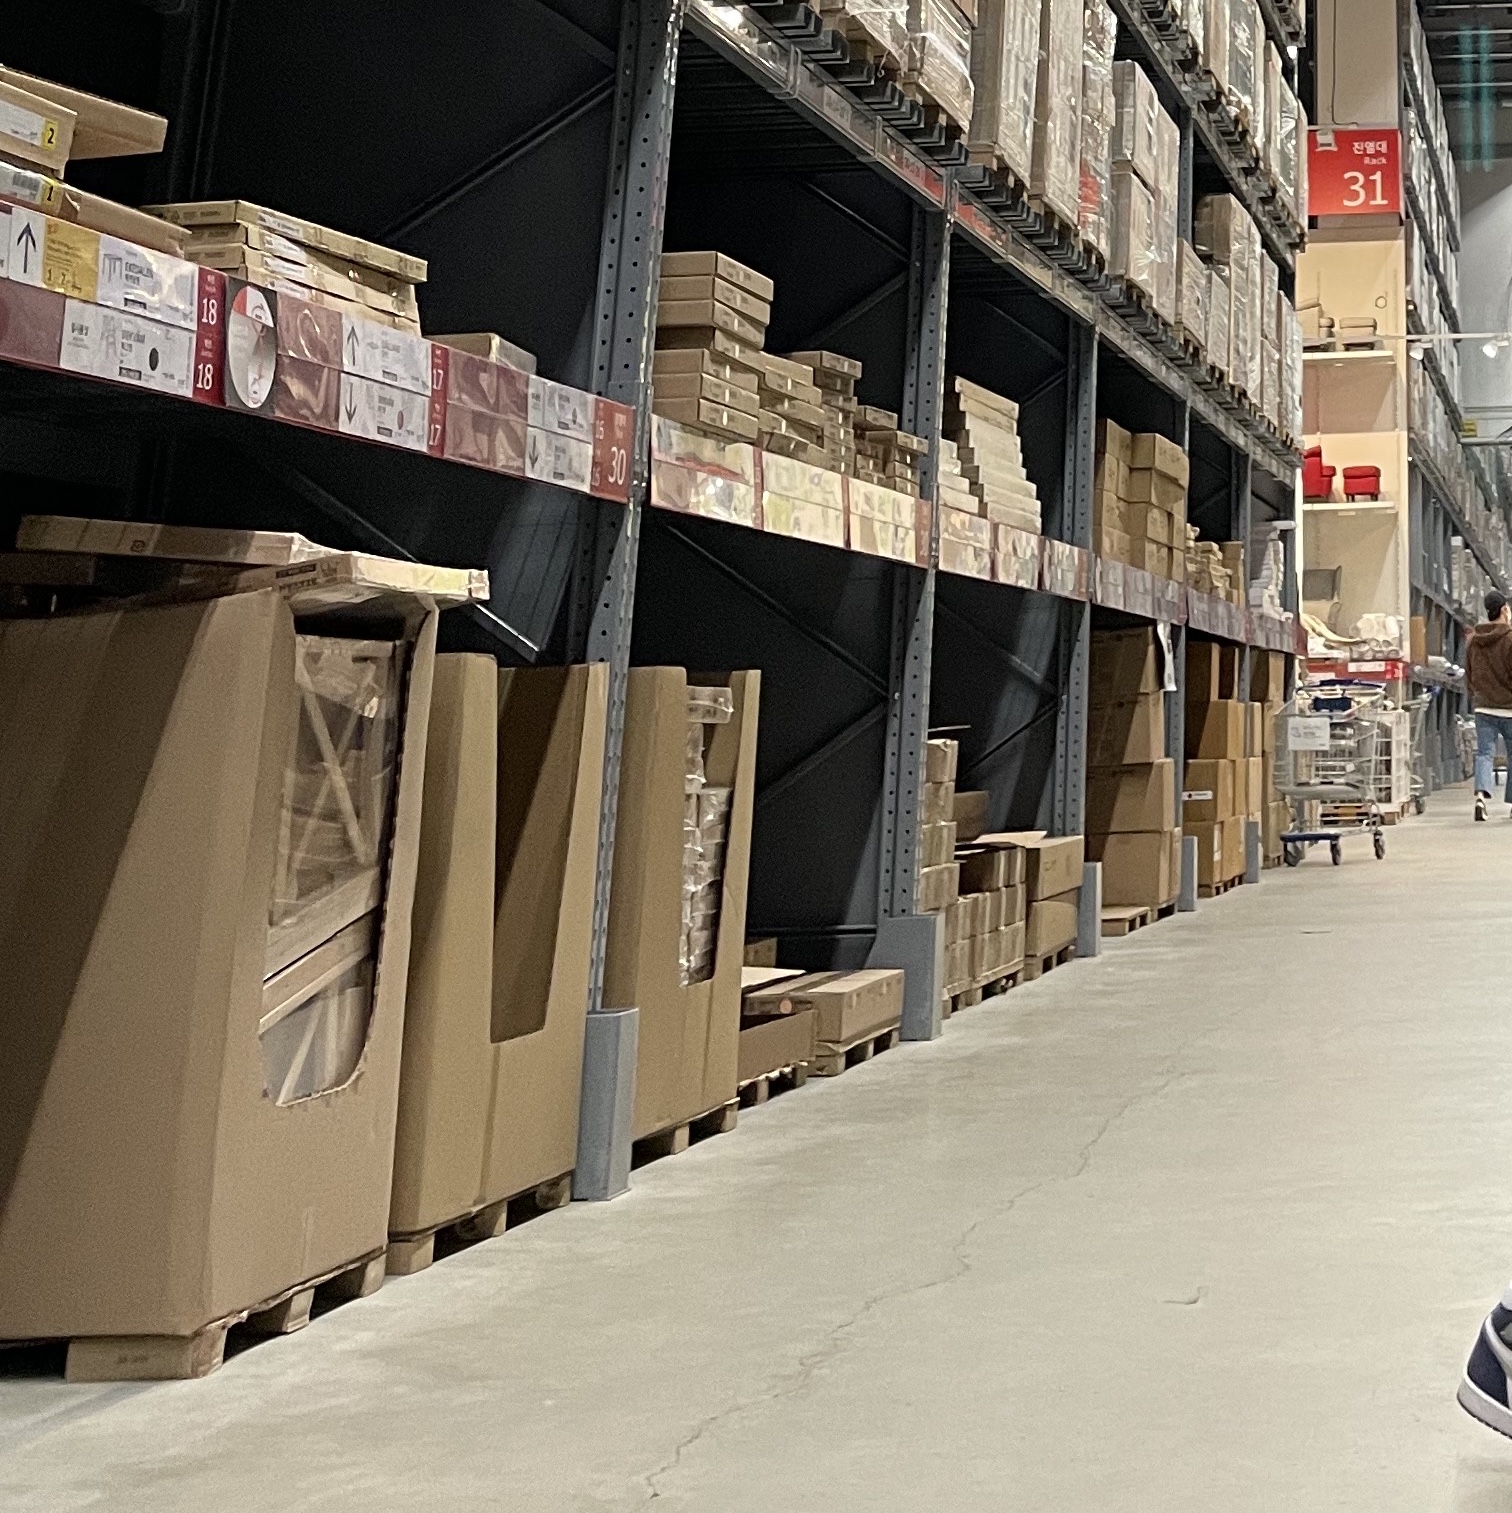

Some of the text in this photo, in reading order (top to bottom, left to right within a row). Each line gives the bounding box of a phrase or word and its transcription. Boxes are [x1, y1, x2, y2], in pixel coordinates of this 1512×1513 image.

[47, 127, 54, 144] 2
[1342, 170, 1389, 207] 31
[201, 296, 218, 326] 18
[196, 362, 214, 390] 18
[432, 368, 444, 391] 17
[428, 423, 442, 447] 17
[608, 446, 627, 486] 30
